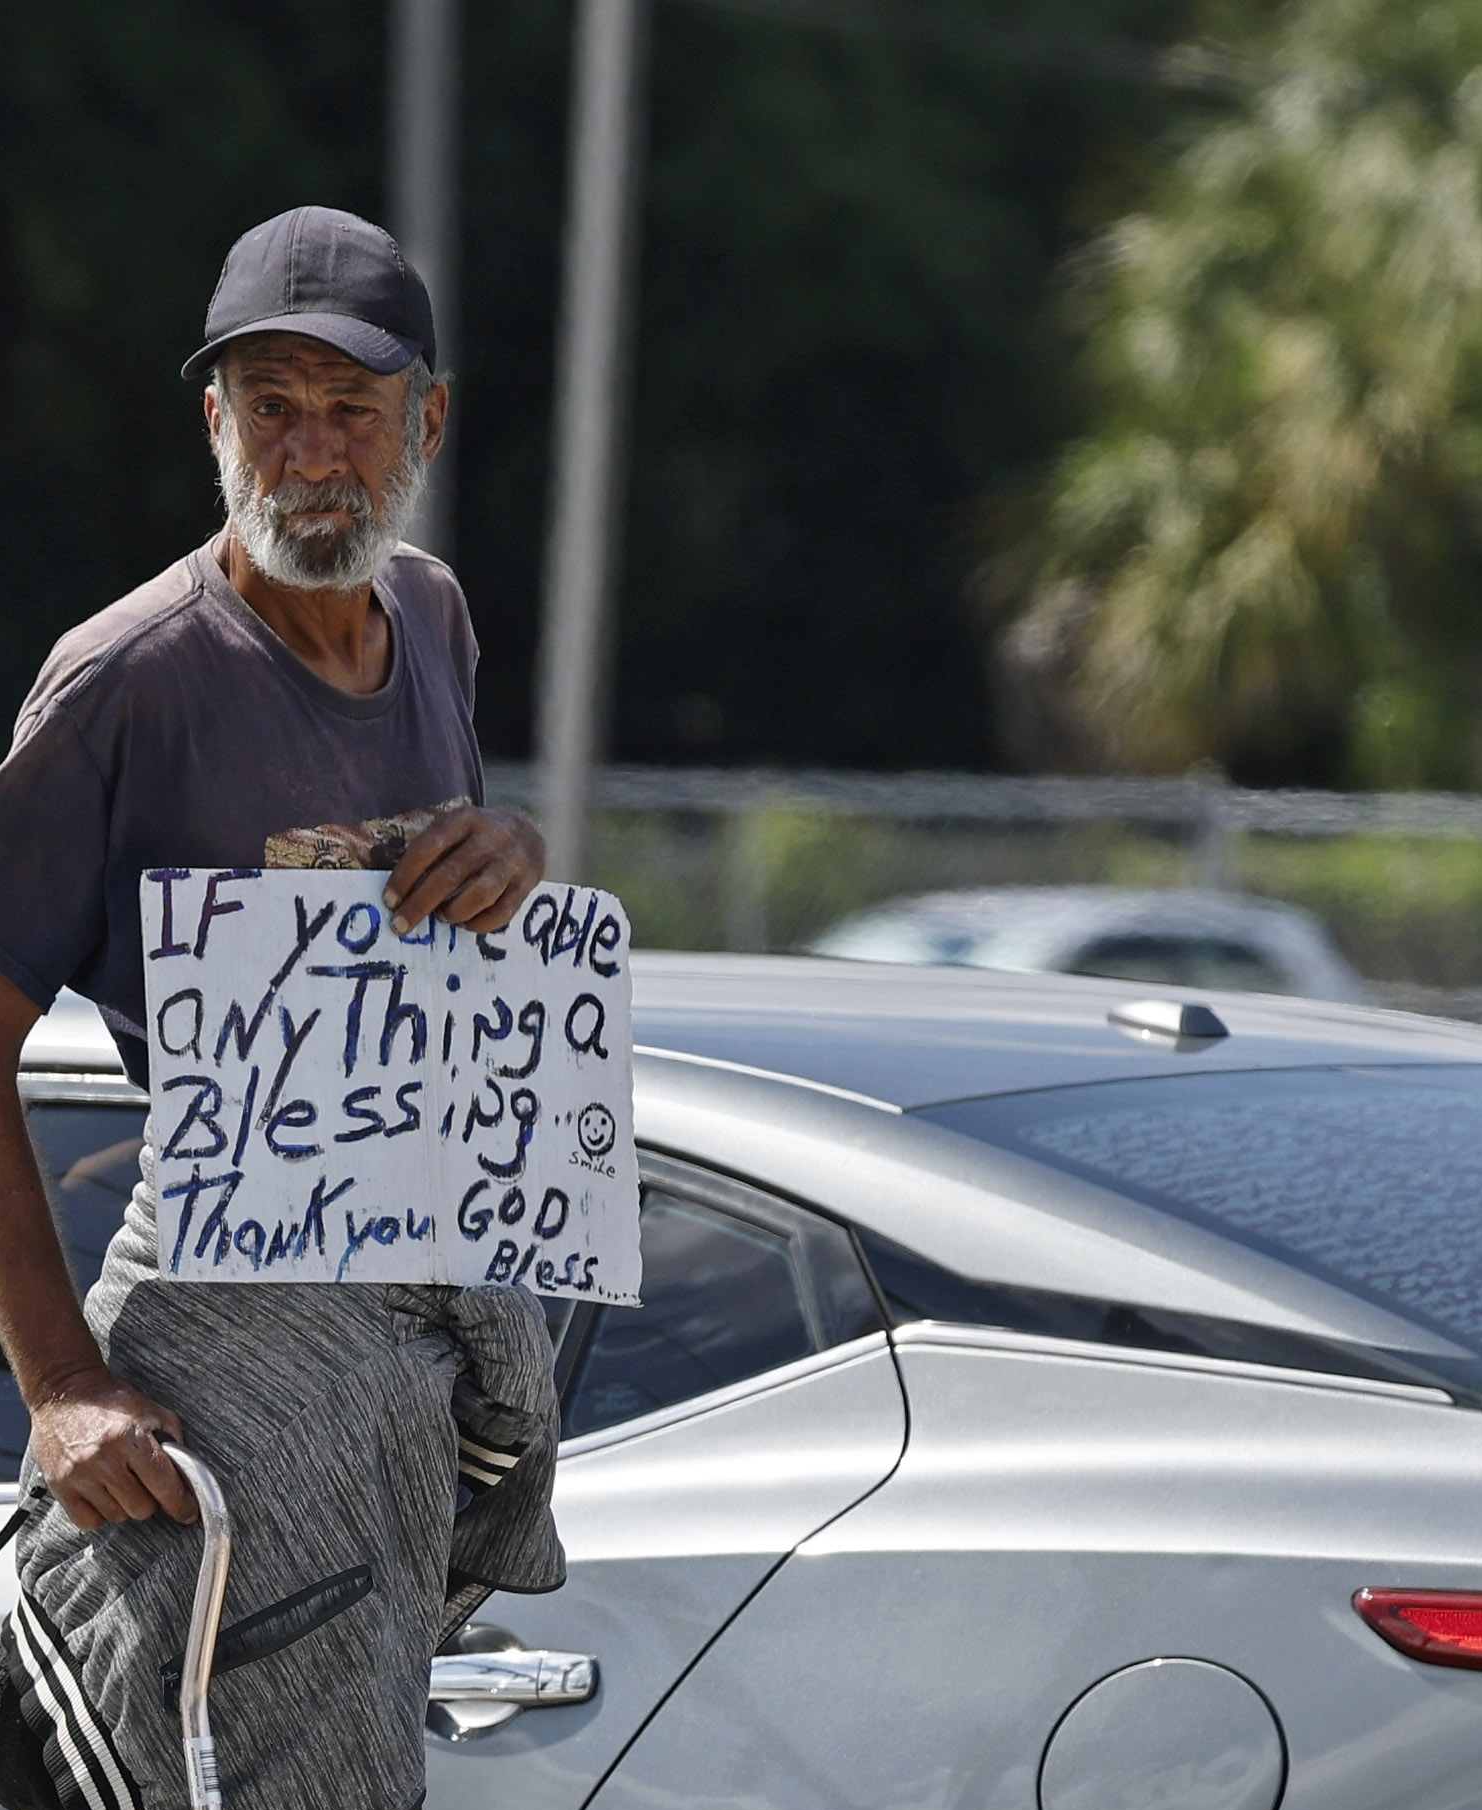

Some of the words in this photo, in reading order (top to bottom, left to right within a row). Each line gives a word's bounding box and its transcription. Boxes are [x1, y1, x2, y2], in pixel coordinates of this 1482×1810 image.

[146, 868, 262, 960] IF
[565, 993, 609, 1060] a
[335, 1208, 437, 1283] you
